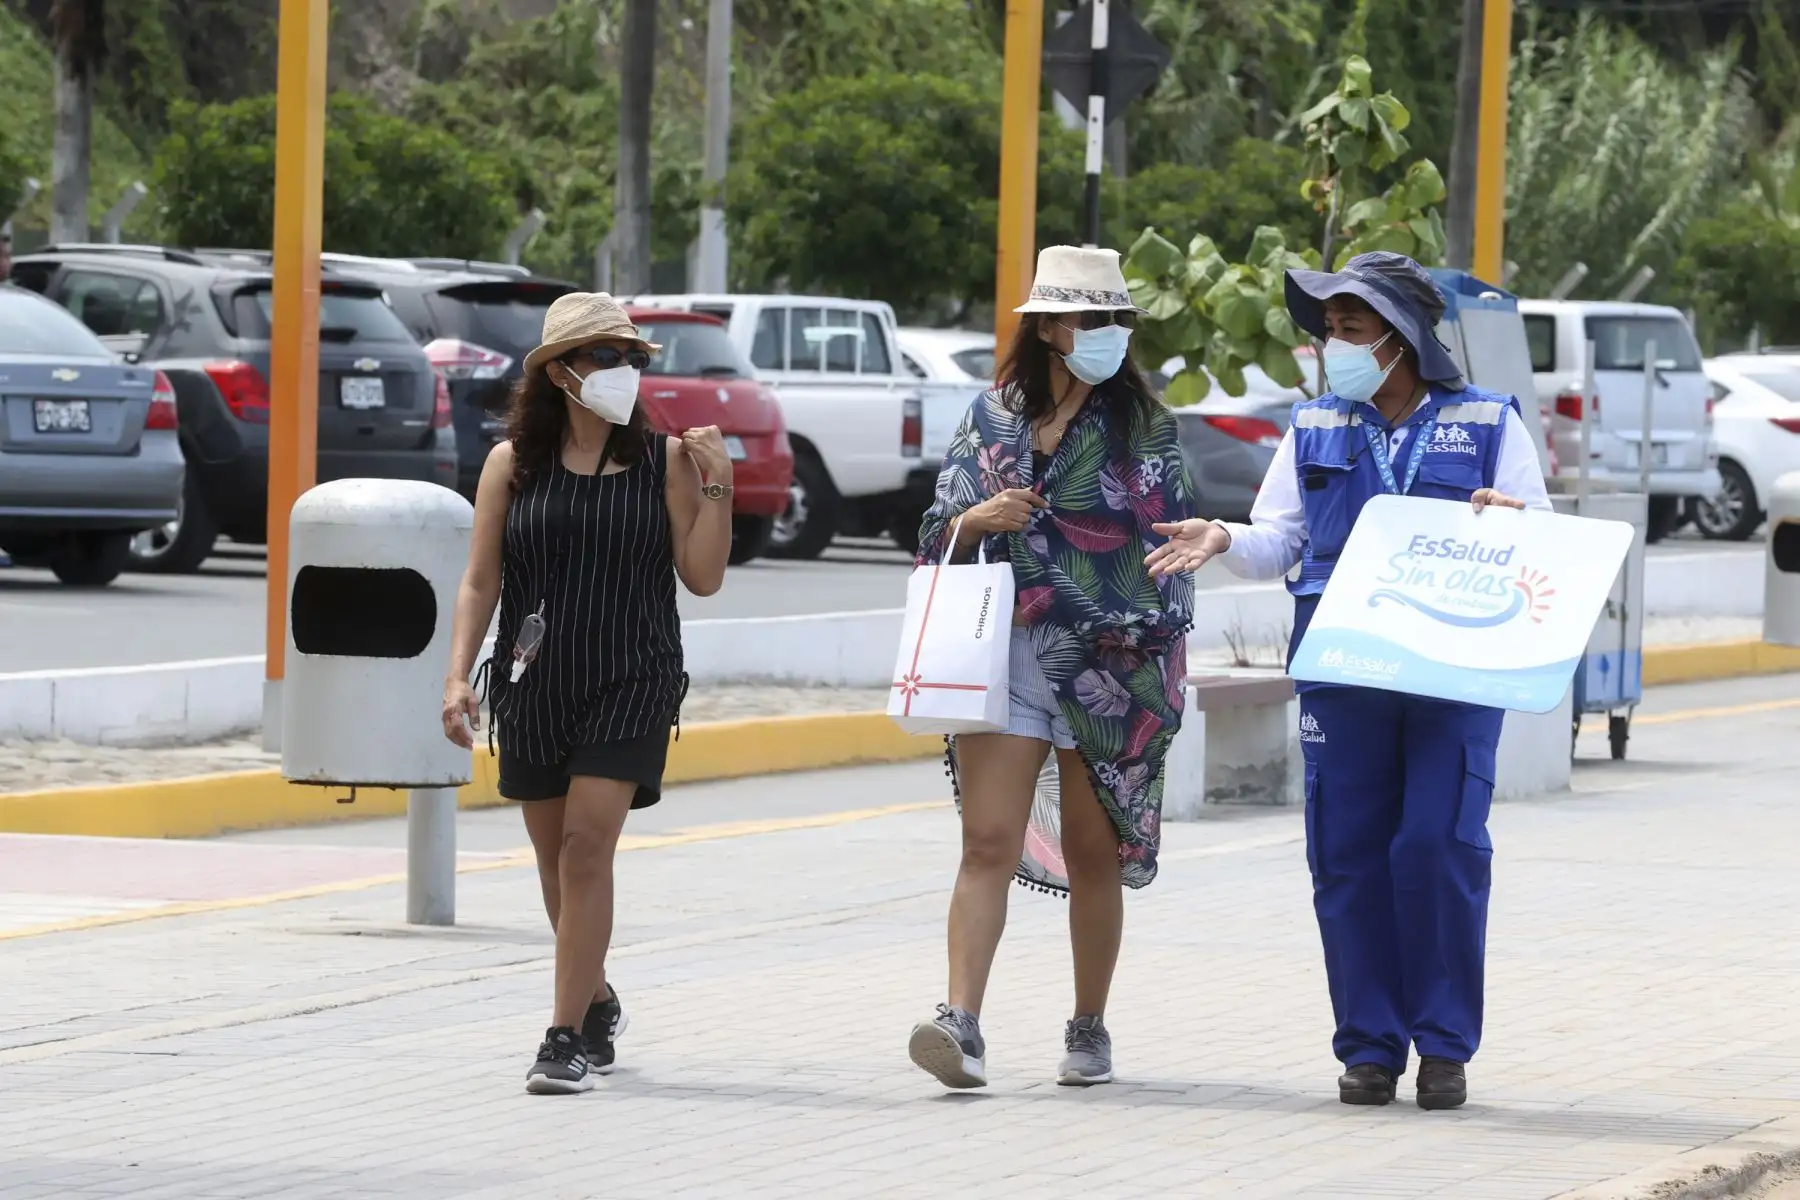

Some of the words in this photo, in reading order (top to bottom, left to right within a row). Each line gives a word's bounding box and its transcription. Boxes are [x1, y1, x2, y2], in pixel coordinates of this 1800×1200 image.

[1426, 442, 1477, 456] EsSalud
[1407, 534, 1516, 566] EsSalud
[1376, 551, 1436, 588] Sin
[1444, 566, 1517, 596] olas
[975, 586, 992, 639] CHRONOS
